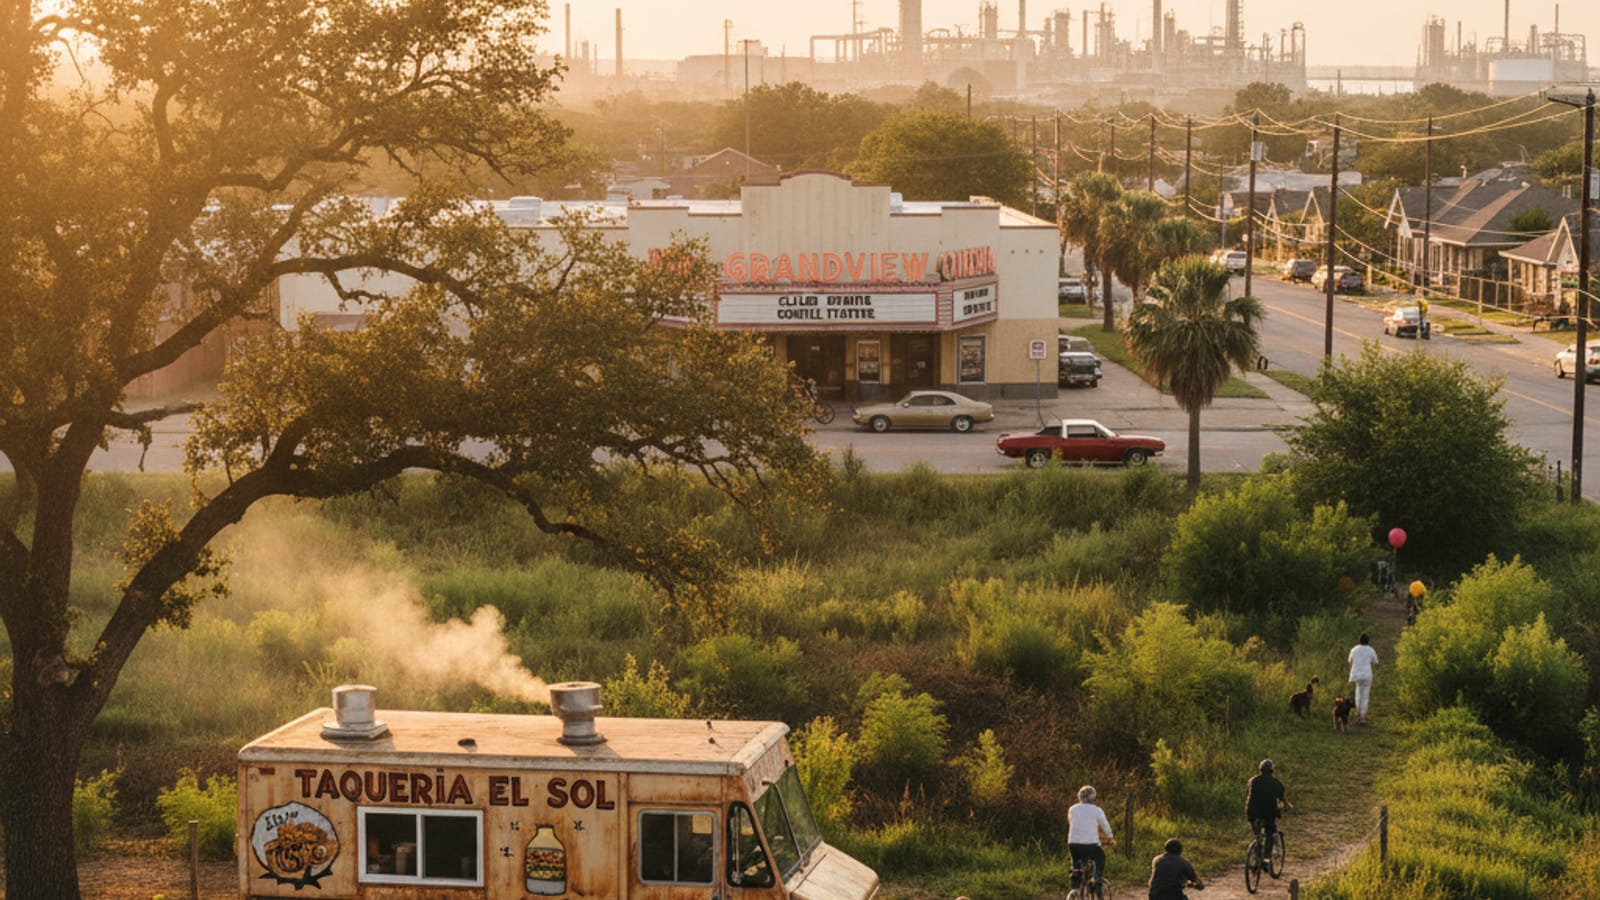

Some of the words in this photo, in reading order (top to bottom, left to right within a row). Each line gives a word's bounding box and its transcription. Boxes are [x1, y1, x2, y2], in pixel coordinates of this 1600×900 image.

[726, 251, 929, 282] GRANDVIEW
[489, 775, 529, 806] EL
[547, 777, 615, 810] SOL
